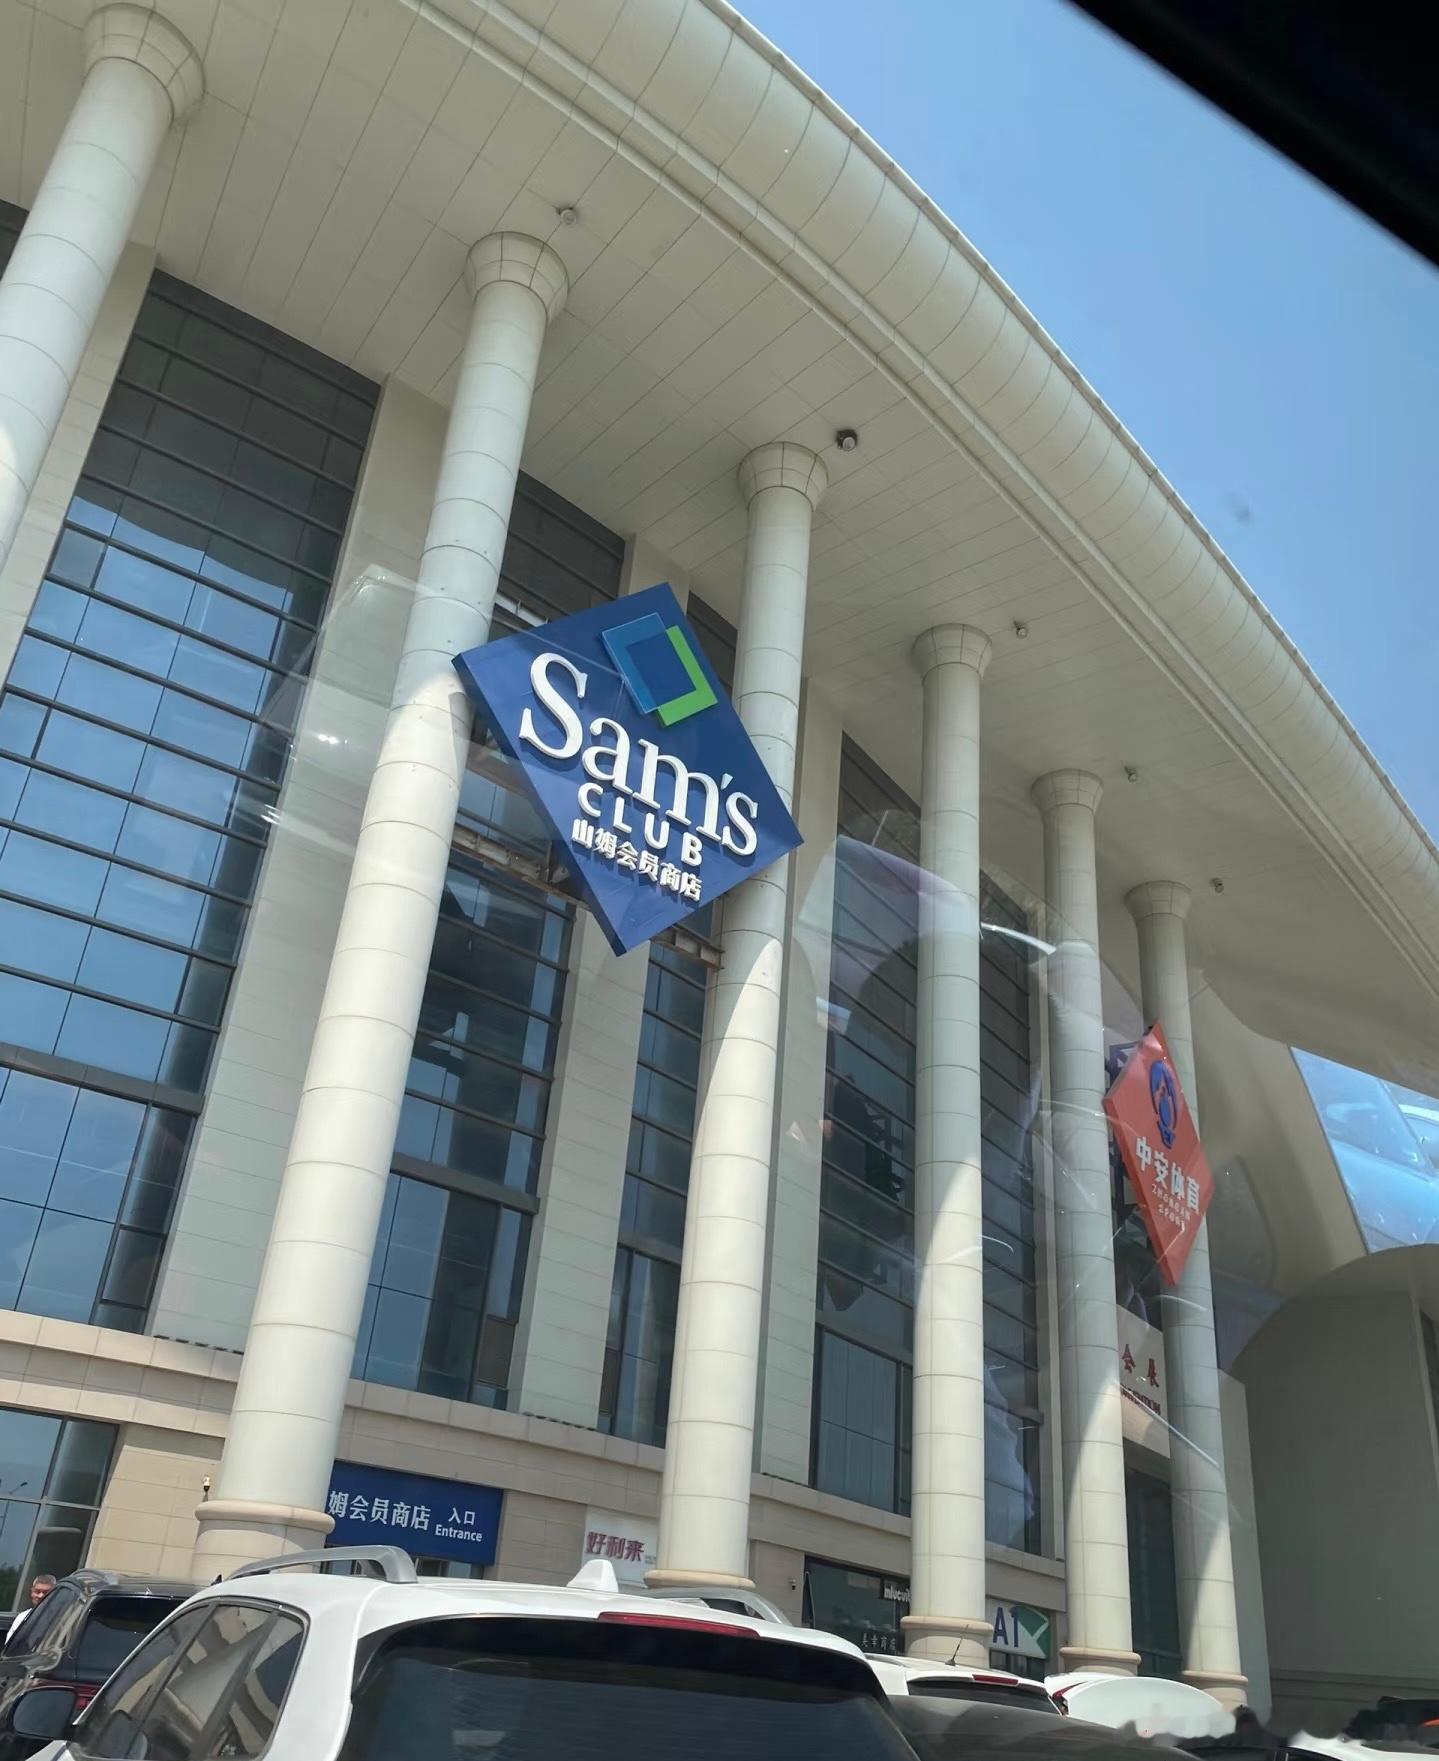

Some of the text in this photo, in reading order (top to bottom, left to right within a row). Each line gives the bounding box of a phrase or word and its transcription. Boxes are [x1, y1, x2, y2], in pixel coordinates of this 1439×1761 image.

[519, 653, 758, 856] Sam's
[572, 819, 703, 902] 山姆会员商店
[577, 783, 703, 867] CLUB
[1136, 1136, 1200, 1216] 中安体育
[327, 1490, 475, 1531] 姆会员商店 入口
[434, 1523, 482, 1542] Entrance
[586, 1531, 645, 1562] 好利来
